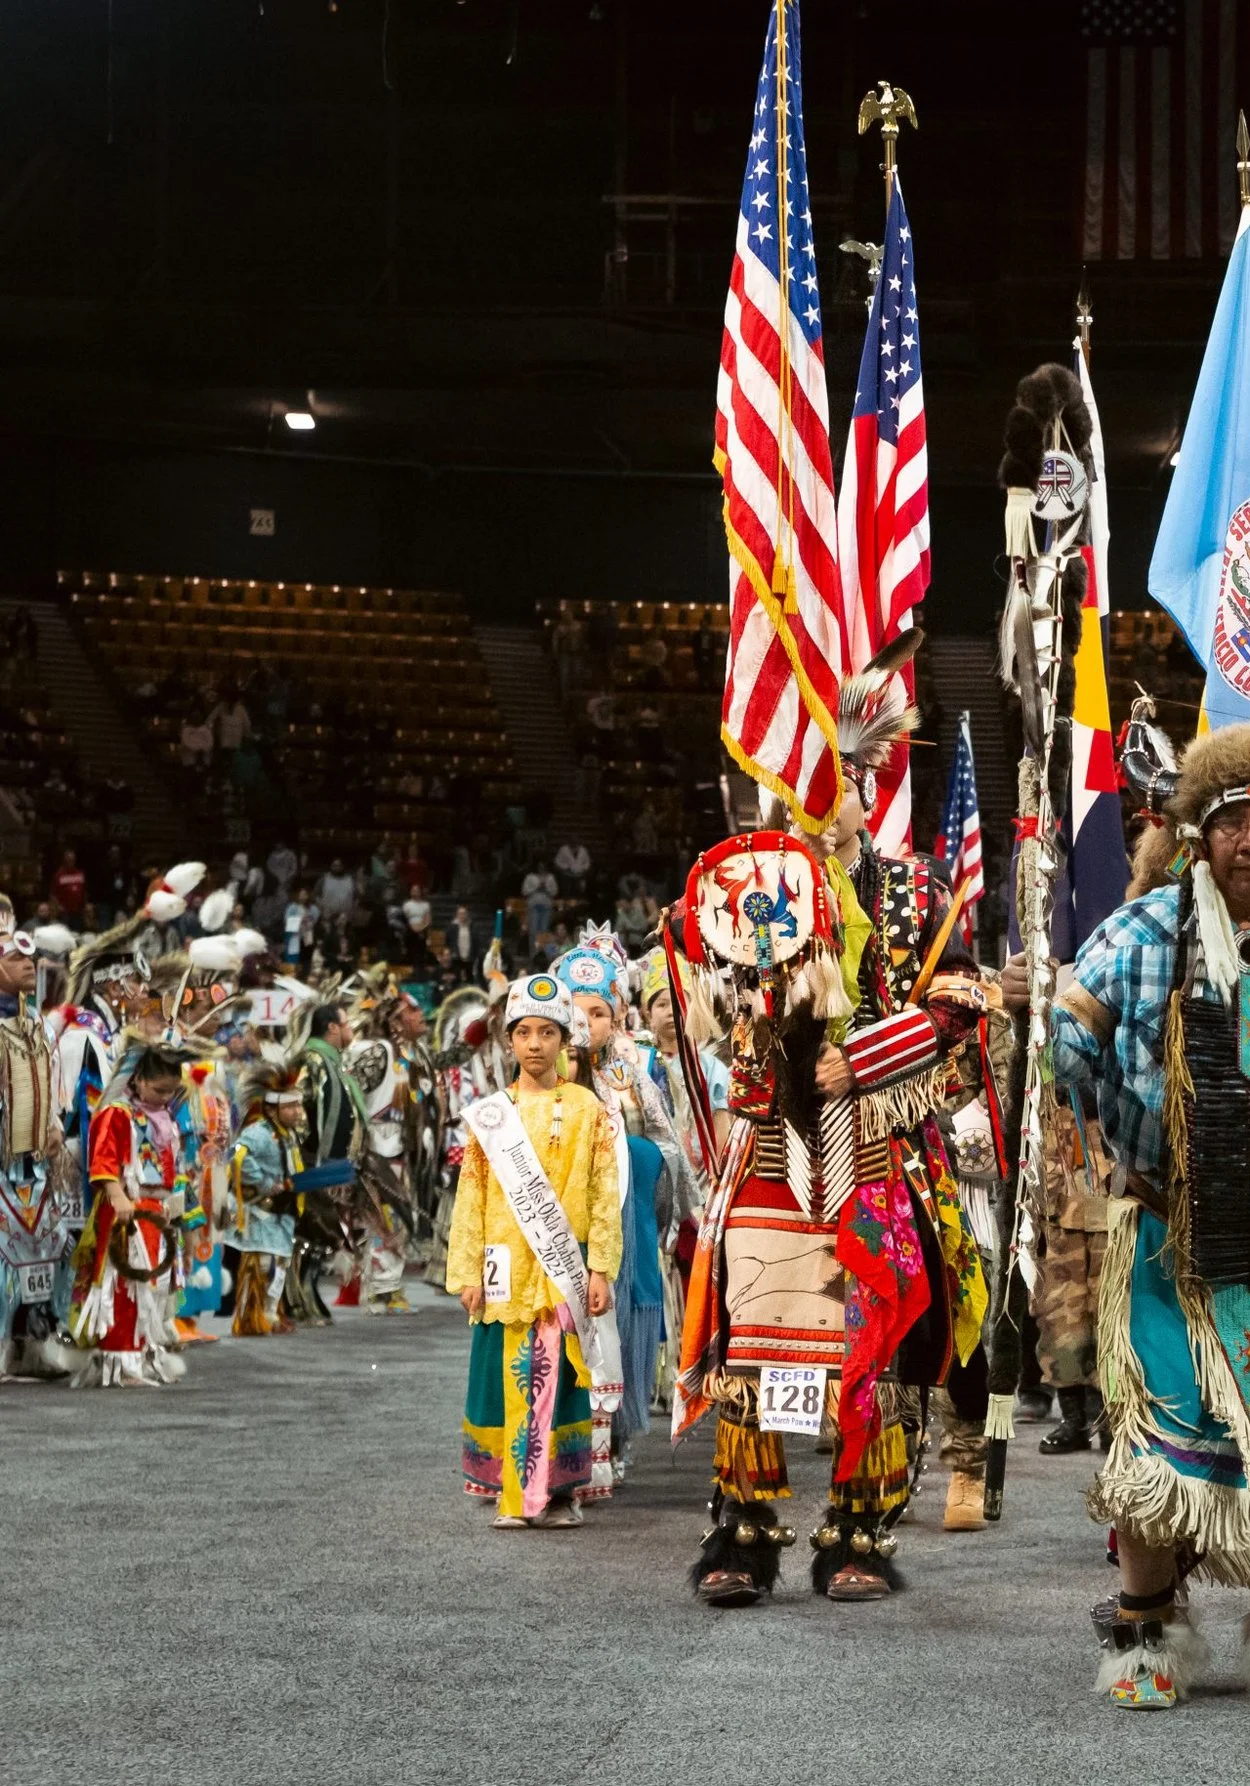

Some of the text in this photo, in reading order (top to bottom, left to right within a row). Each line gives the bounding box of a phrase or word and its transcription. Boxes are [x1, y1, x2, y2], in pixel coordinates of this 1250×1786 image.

[502, 1140, 532, 1178] Junior
[523, 1175, 546, 1204] Miss
[538, 1202, 562, 1232] Okla
[552, 1232, 576, 1273] Chahta
[509, 1187, 537, 1223] 2023
[538, 1245, 566, 1278] 2024
[27, 1274, 52, 1293] 645
[769, 1370, 815, 1383] SCFD
[763, 1385, 820, 1415] 128
[772, 1416, 790, 1425] March
